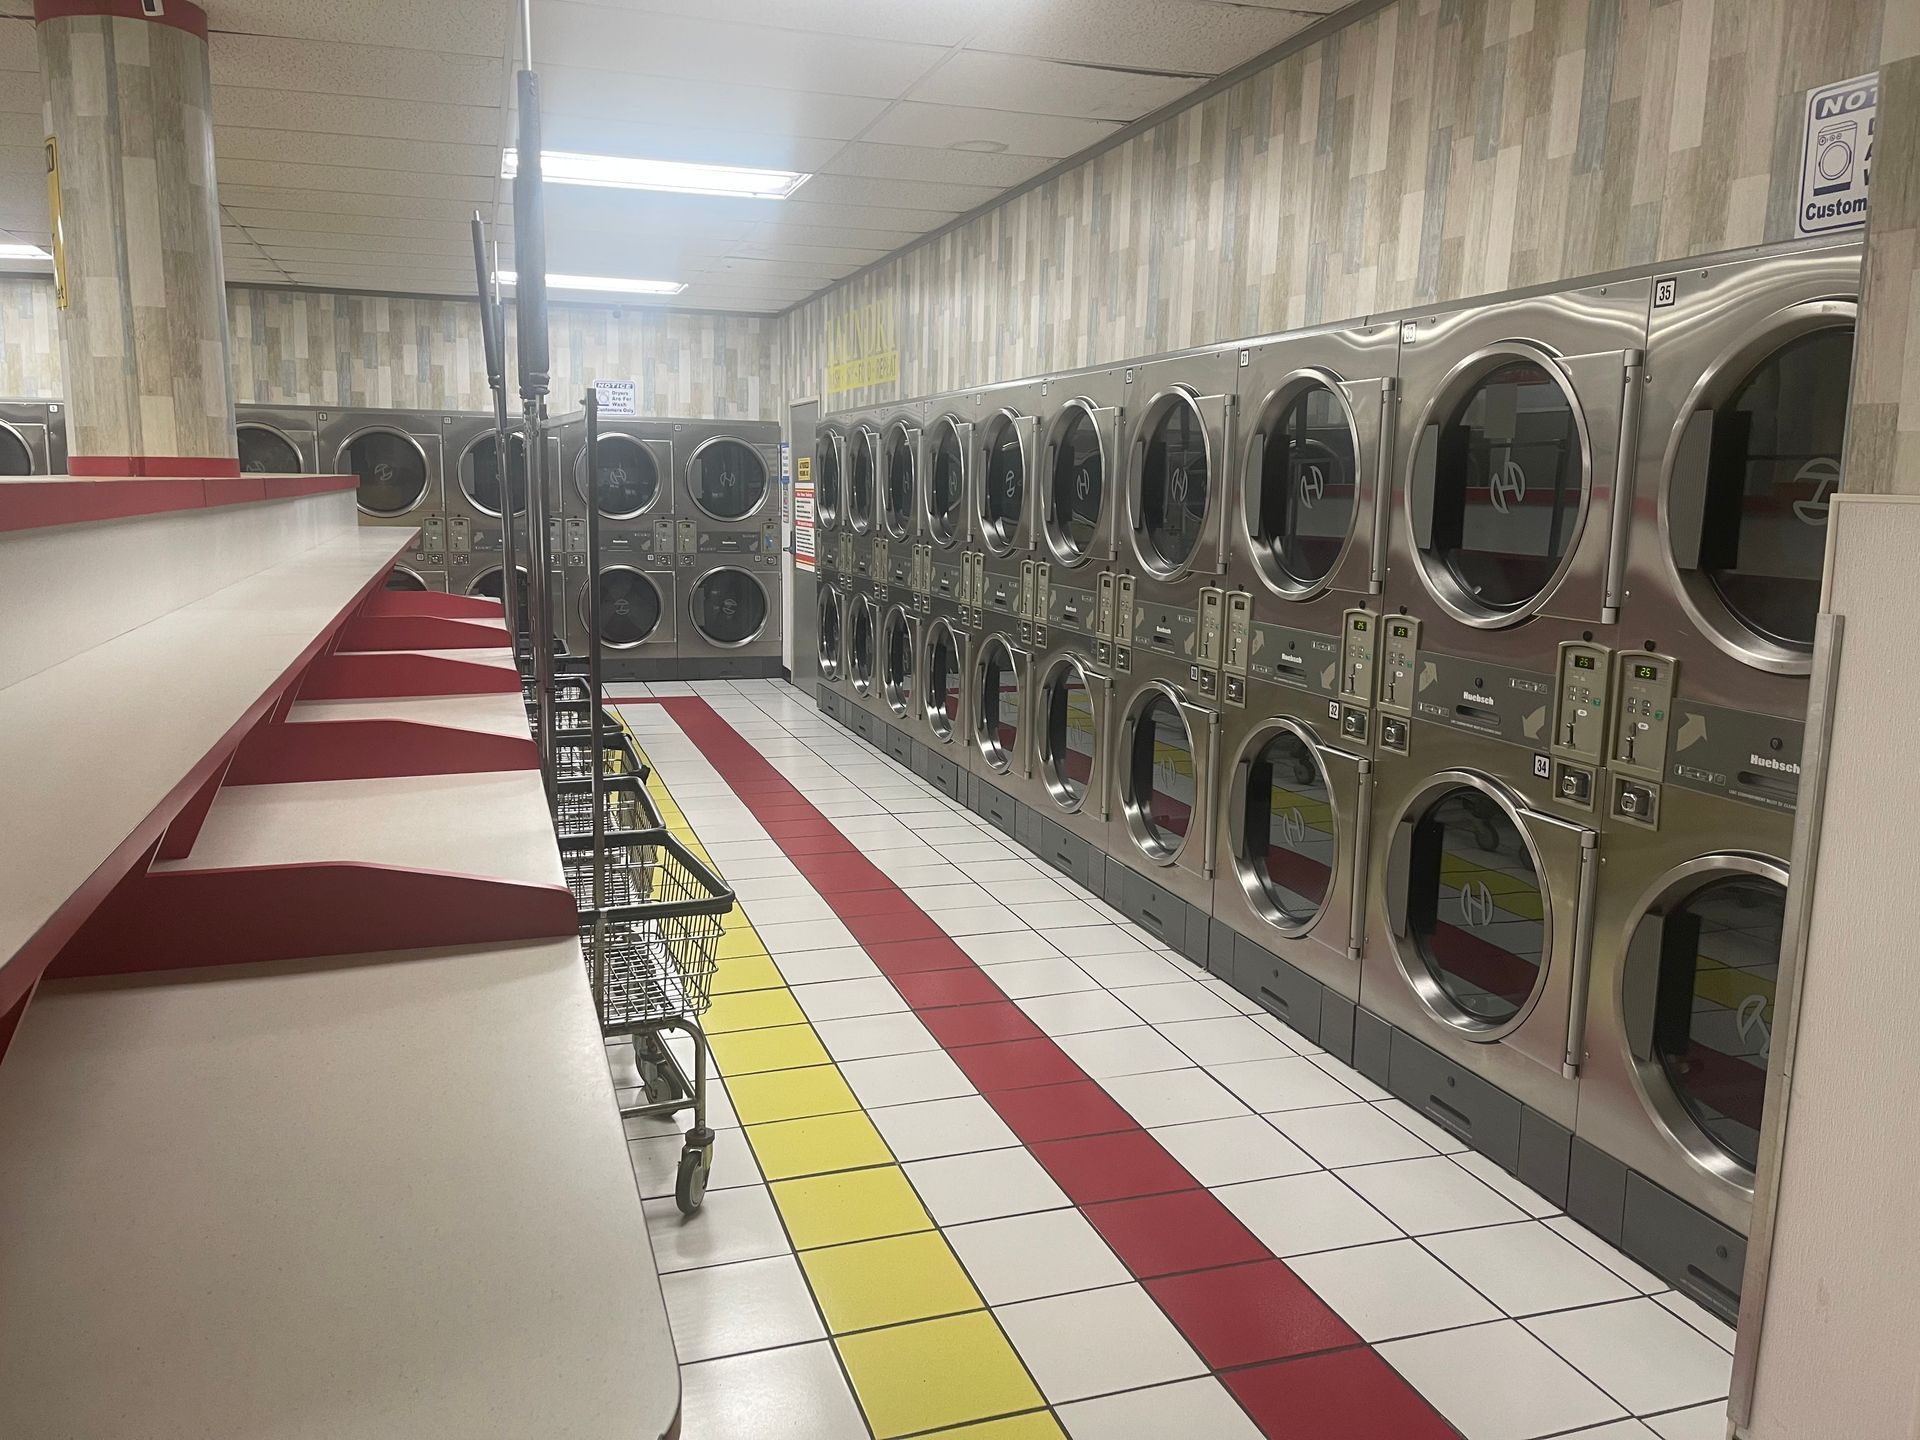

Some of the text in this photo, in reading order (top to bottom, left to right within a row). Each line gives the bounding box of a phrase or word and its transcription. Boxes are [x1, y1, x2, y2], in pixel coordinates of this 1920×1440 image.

[1659, 285, 1671, 301] 35
[1579, 657, 1589, 667] 25
[1640, 667, 1651, 677] 25
[1463, 691, 1494, 706] Huebsch
[1330, 704, 1338, 717] 32
[1537, 759, 1547, 774] 34
[1750, 753, 1801, 775] Huebsch
